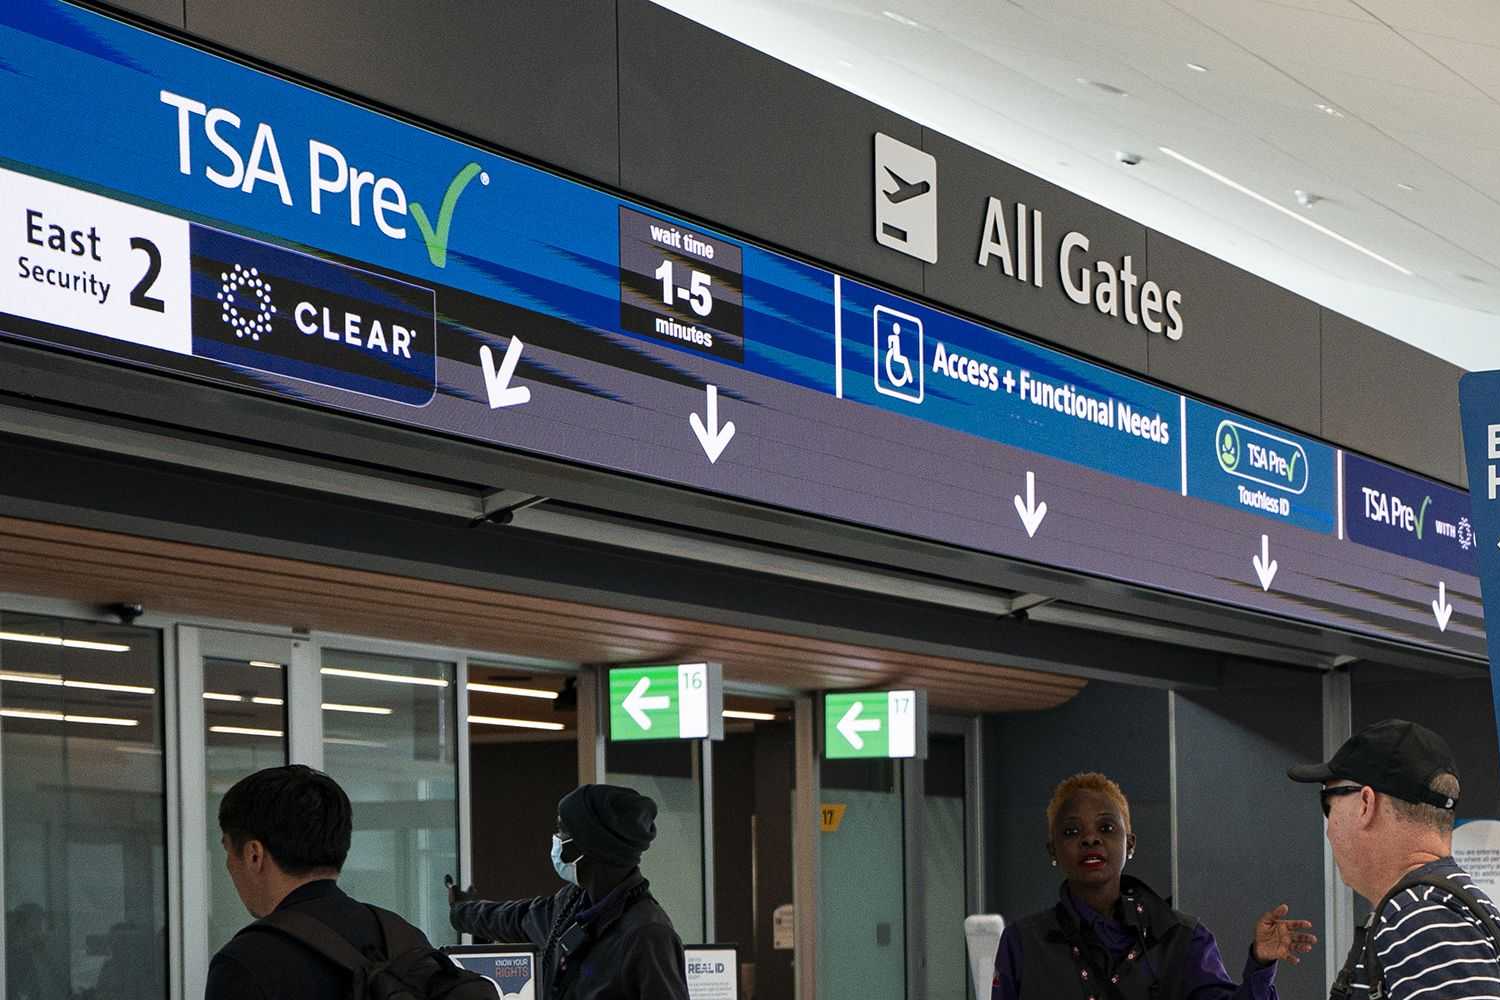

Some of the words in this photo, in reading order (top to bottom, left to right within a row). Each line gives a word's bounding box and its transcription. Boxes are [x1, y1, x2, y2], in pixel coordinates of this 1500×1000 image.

[160, 90, 293, 206] TSA
[309, 139, 407, 239] Pre
[26, 208, 101, 262] East
[650, 225, 681, 248] wait
[683, 234, 714, 259] time
[18, 256, 110, 304] Security
[129, 237, 165, 313] 2
[655, 260, 713, 317] 1-5
[978, 196, 1043, 288] All
[1060, 232, 1183, 341] Gates
[295, 301, 411, 358] CLEAR
[655, 318, 713, 347] minutes
[932, 342, 999, 391] Access
[1003, 370, 1016, 393] +
[1020, 368, 1114, 428] Functional
[1117, 402, 1170, 445] Needs
[1247, 443, 1270, 471] TSA
[1271, 450, 1287, 474] Pre
[1238, 485, 1279, 513] Touchless
[1280, 499, 1290, 516] ID
[1362, 487, 1390, 525] TSA
[1391, 496, 1415, 532] Pre
[1435, 520, 1456, 538] WITH
[682, 672, 702, 689] 16
[895, 698, 909, 713] 17
[822, 810, 833, 825] 17
[496, 966, 528, 977] RIGHTS
[688, 963, 714, 974] REAL
[715, 963, 725, 973] ID
